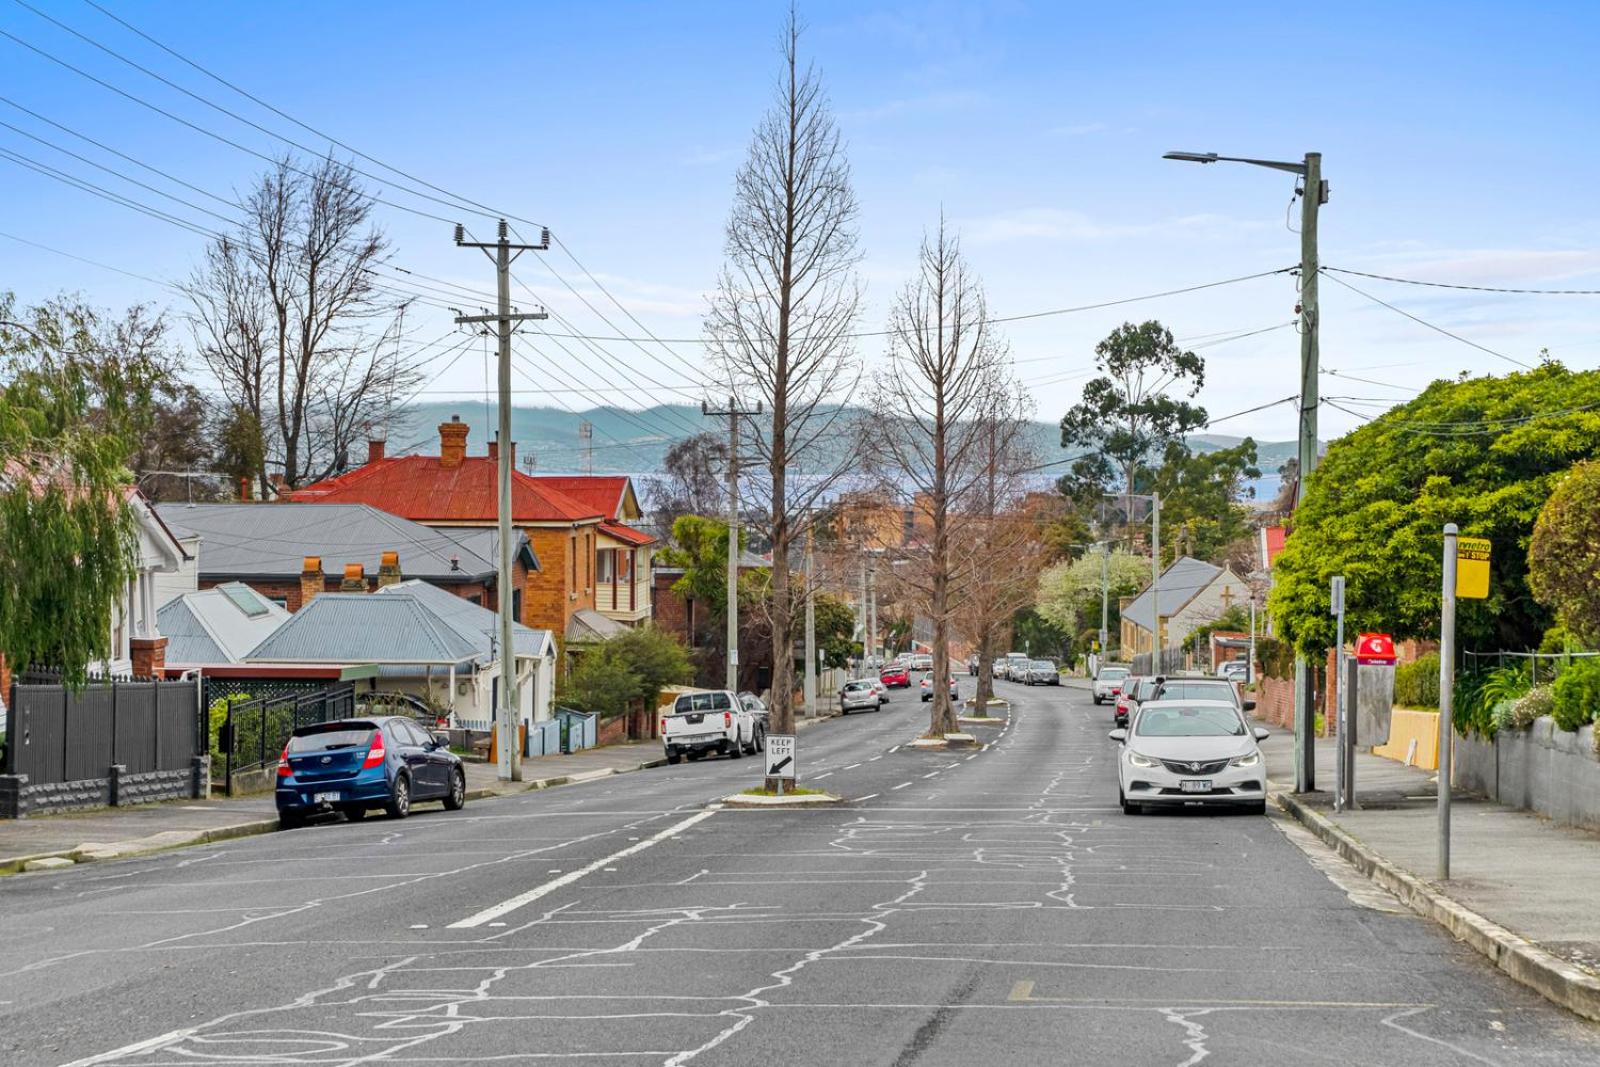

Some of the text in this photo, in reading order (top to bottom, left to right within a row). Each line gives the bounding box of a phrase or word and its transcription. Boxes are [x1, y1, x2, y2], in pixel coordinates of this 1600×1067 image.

[1458, 541, 1490, 551] metro
[1471, 552, 1490, 560] STOP
[771, 747, 790, 755] LEFT
